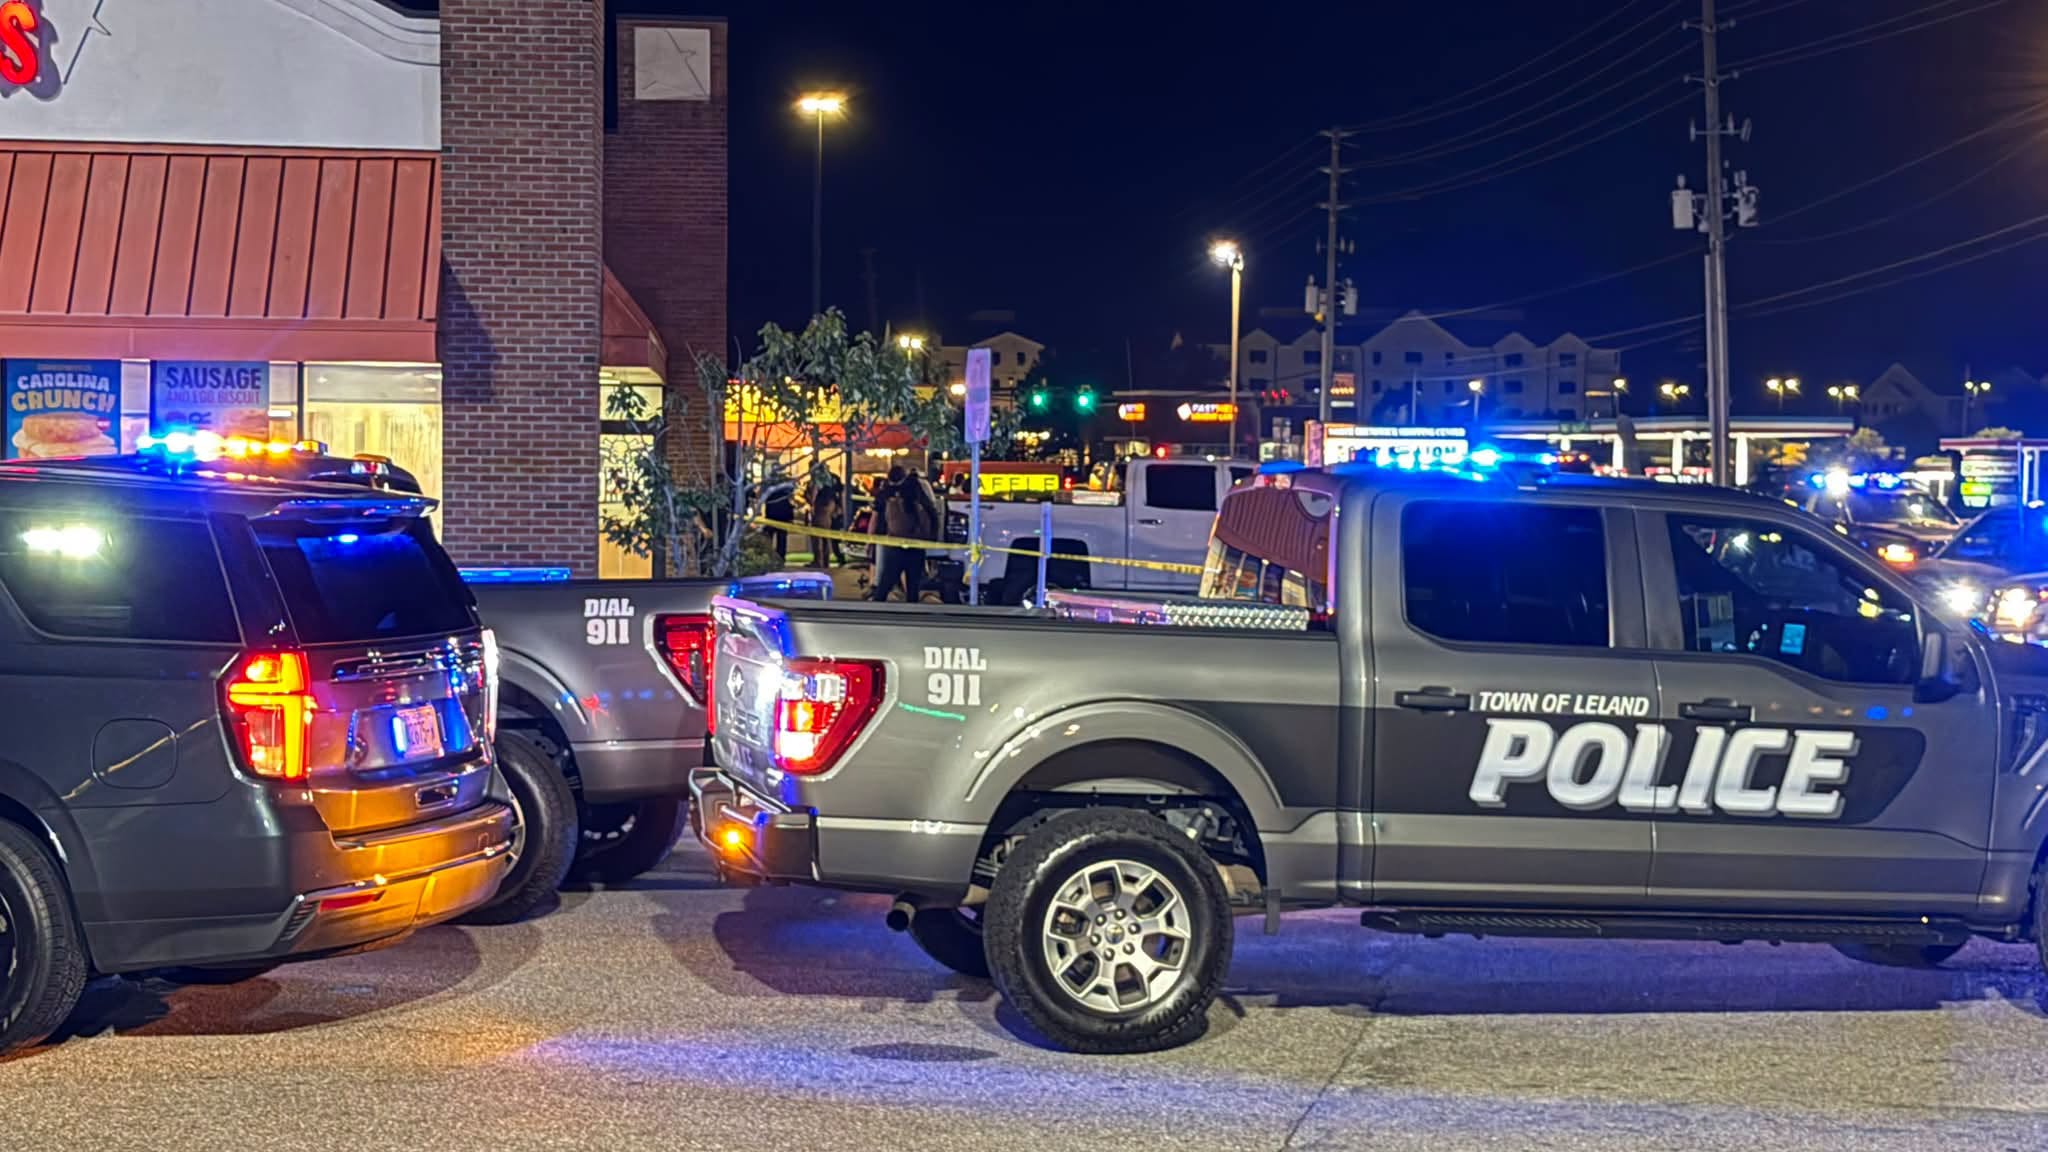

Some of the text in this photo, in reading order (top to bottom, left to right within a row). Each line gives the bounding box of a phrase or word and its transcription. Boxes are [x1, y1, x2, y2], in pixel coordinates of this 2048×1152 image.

[17, 373, 110, 391] CAROLINA
[166, 367, 262, 389] SAUSAGE
[11, 389, 116, 412] CRUNCH
[584, 598, 635, 617] DIAL
[586, 618, 630, 645] 911
[924, 646, 987, 671] DIAL
[928, 672, 981, 706] 911
[1479, 691, 1650, 716] TOWN OF LELAND
[1468, 717, 1860, 818] POLICE
